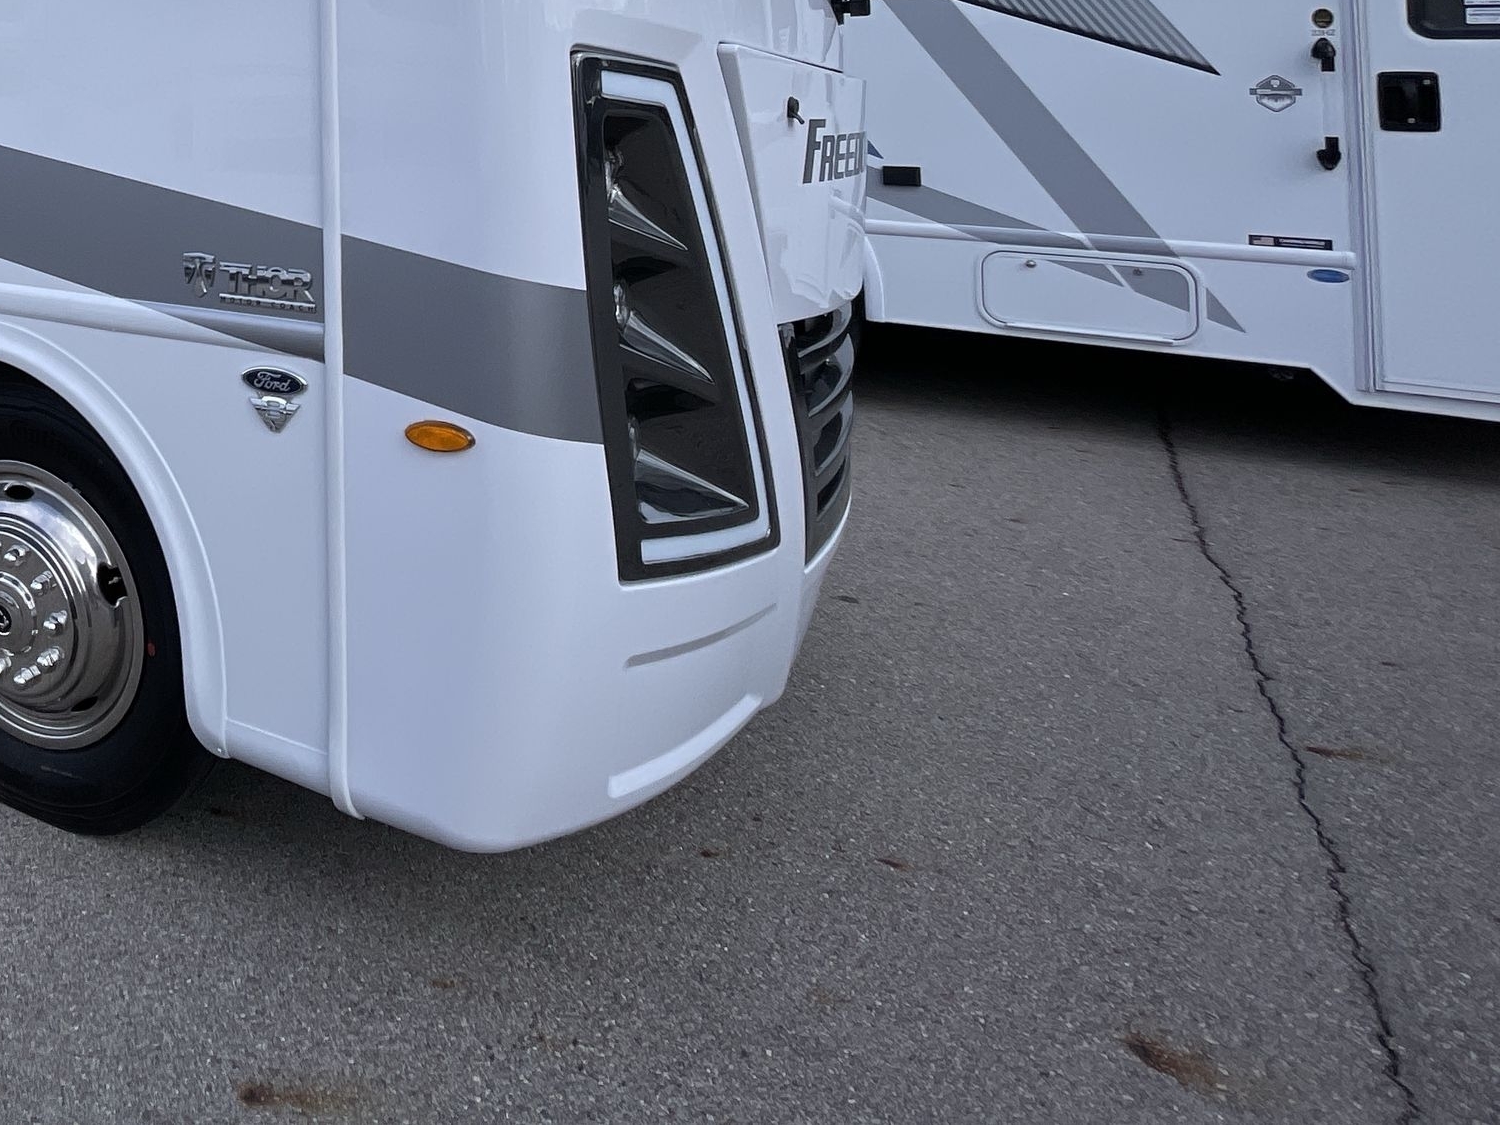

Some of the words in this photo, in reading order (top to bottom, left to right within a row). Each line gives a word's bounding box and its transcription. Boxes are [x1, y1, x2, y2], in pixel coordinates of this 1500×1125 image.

[219, 260, 315, 302] THOR
[219, 295, 262, 308] MOTOR
[270, 302, 317, 314] COACH
[253, 371, 291, 391] Ford
